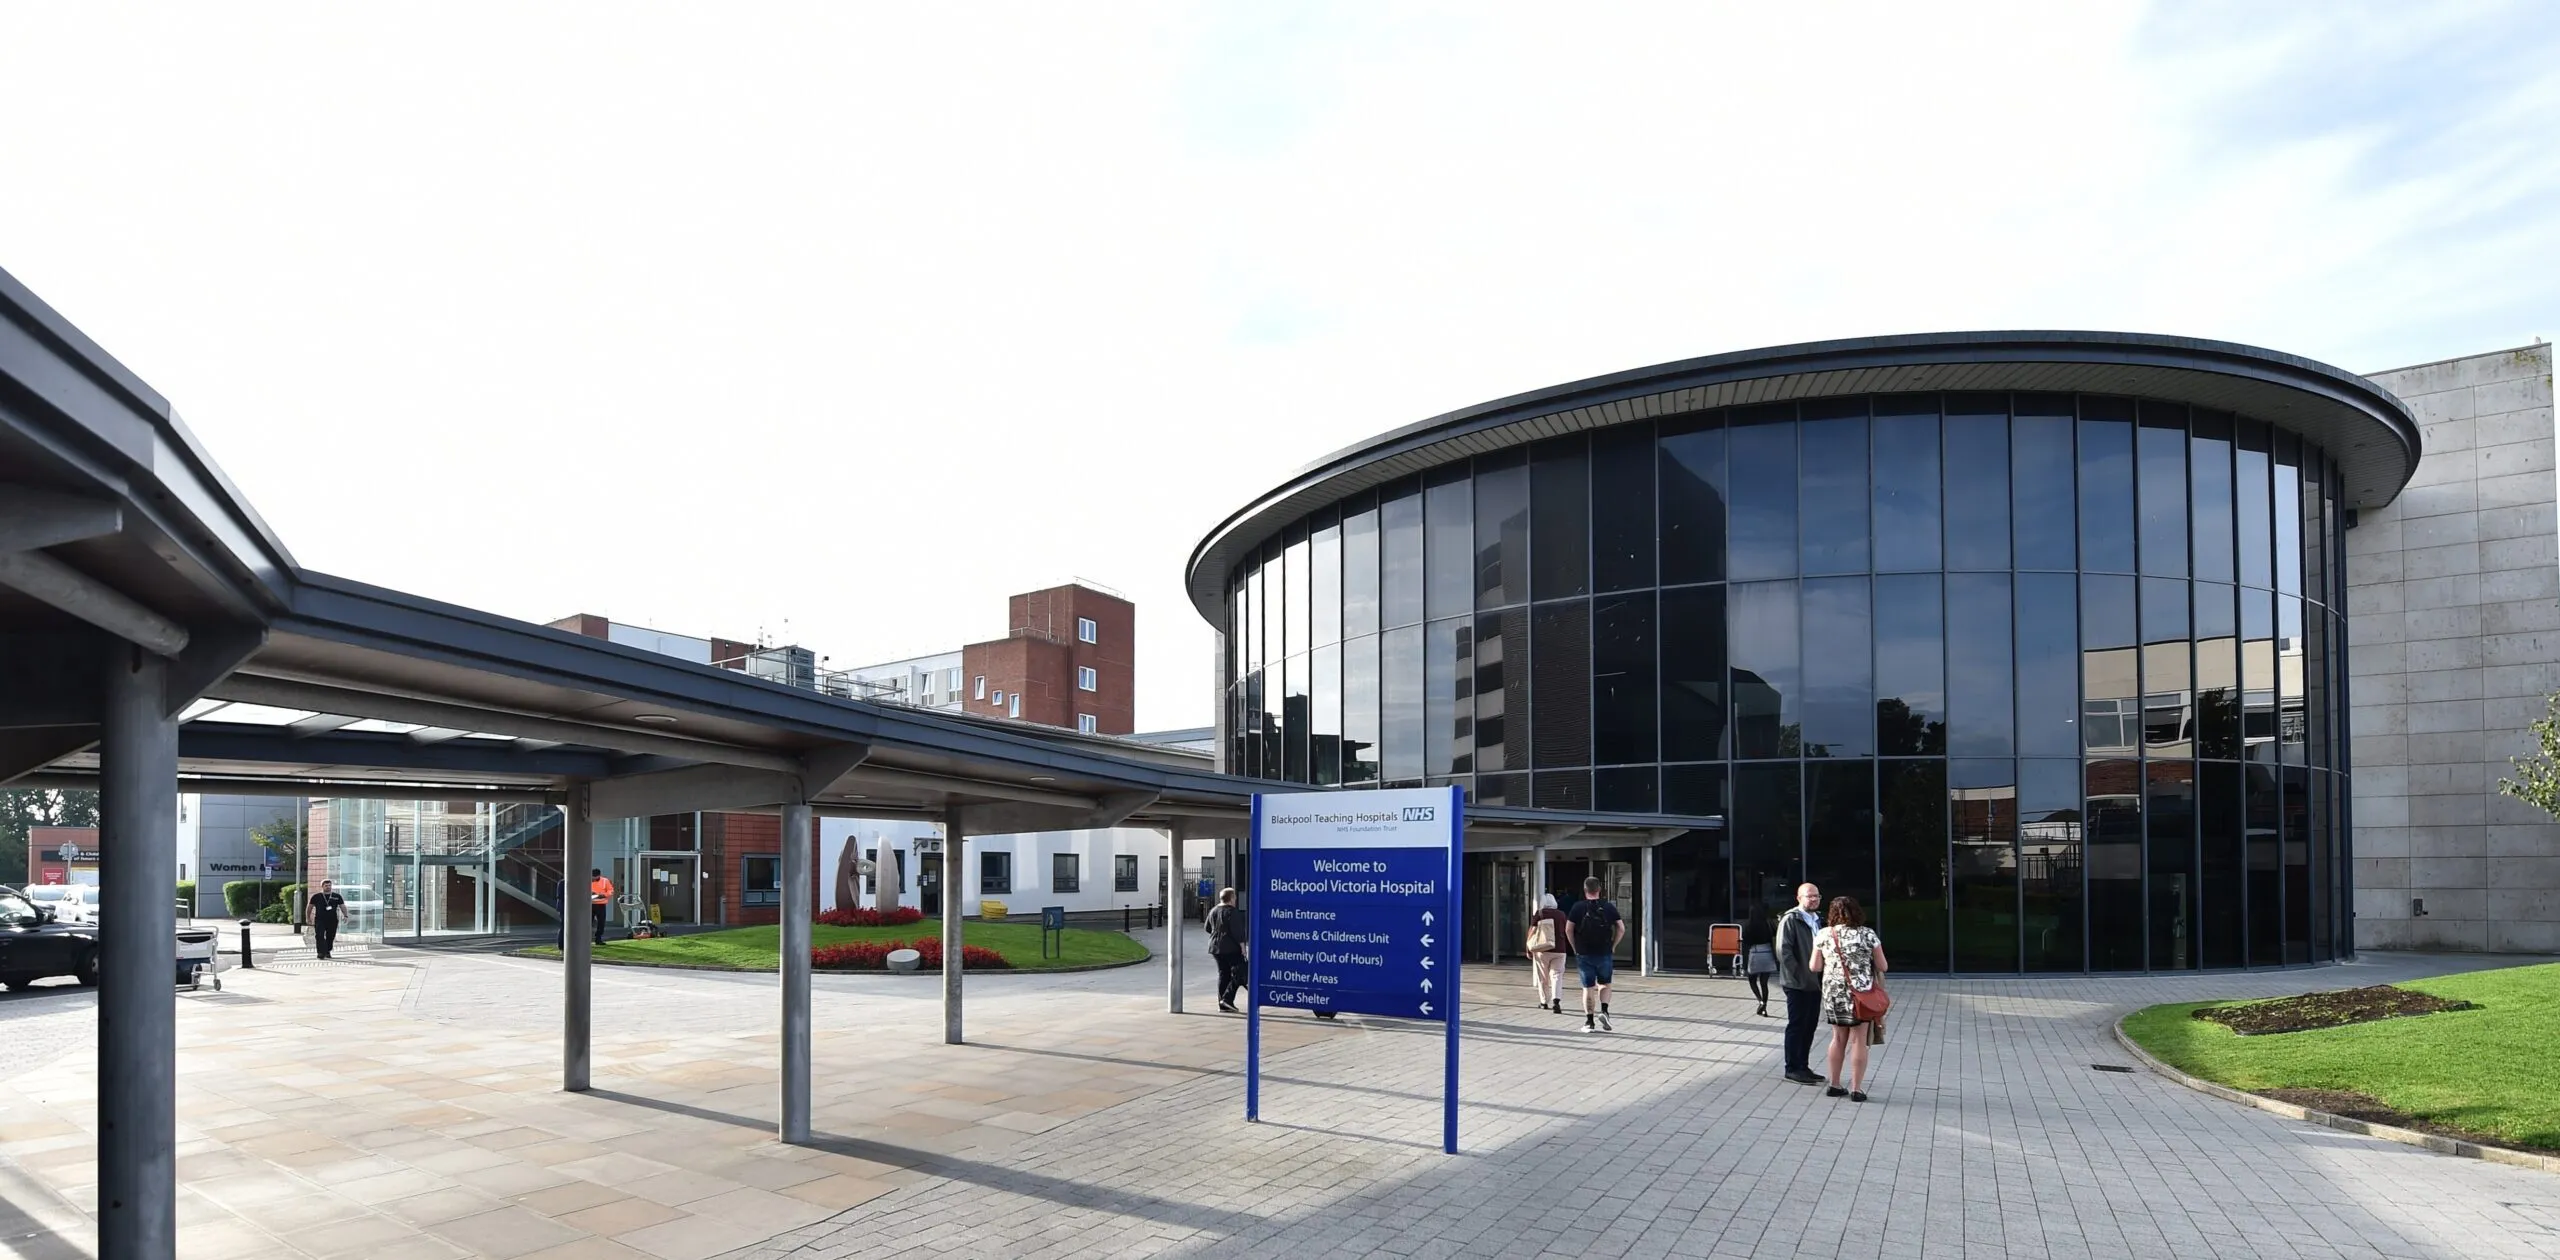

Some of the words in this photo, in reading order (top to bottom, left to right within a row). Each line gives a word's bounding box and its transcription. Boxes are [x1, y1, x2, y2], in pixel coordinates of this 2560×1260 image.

[1271, 814, 1312, 826] Blackpool
[1315, 813, 1354, 825] Teaching
[1356, 811, 1398, 824] Hospitals
[1403, 807, 1434, 821] NHS
[1350, 825, 1382, 833] Foundation
[210, 863, 256, 872] Women
[1313, 859, 1371, 873] Welcome
[1372, 861, 1387, 873] to
[1270, 878, 1328, 895] Blackpool
[1329, 879, 1377, 894] Victoria
[1380, 880, 1435, 897] Hospital
[1271, 908, 1293, 919] Main
[1295, 909, 1337, 921] Entrance
[1270, 929, 1310, 941] Womens
[1311, 930, 1320, 941] &
[1321, 931, 1367, 943] Childrens
[1368, 932, 1390, 944] Unit
[1270, 949, 1314, 964] Maternity
[1316, 951, 1337, 964] (Out
[1338, 952, 1350, 964] of
[1351, 953, 1384, 967] Hours)
[1270, 970, 1282, 981] All
[1284, 970, 1311, 983] Other
[1312, 972, 1339, 985] Areas
[1269, 990, 1294, 1004] Cycle
[1296, 992, 1330, 1005] Shelter
